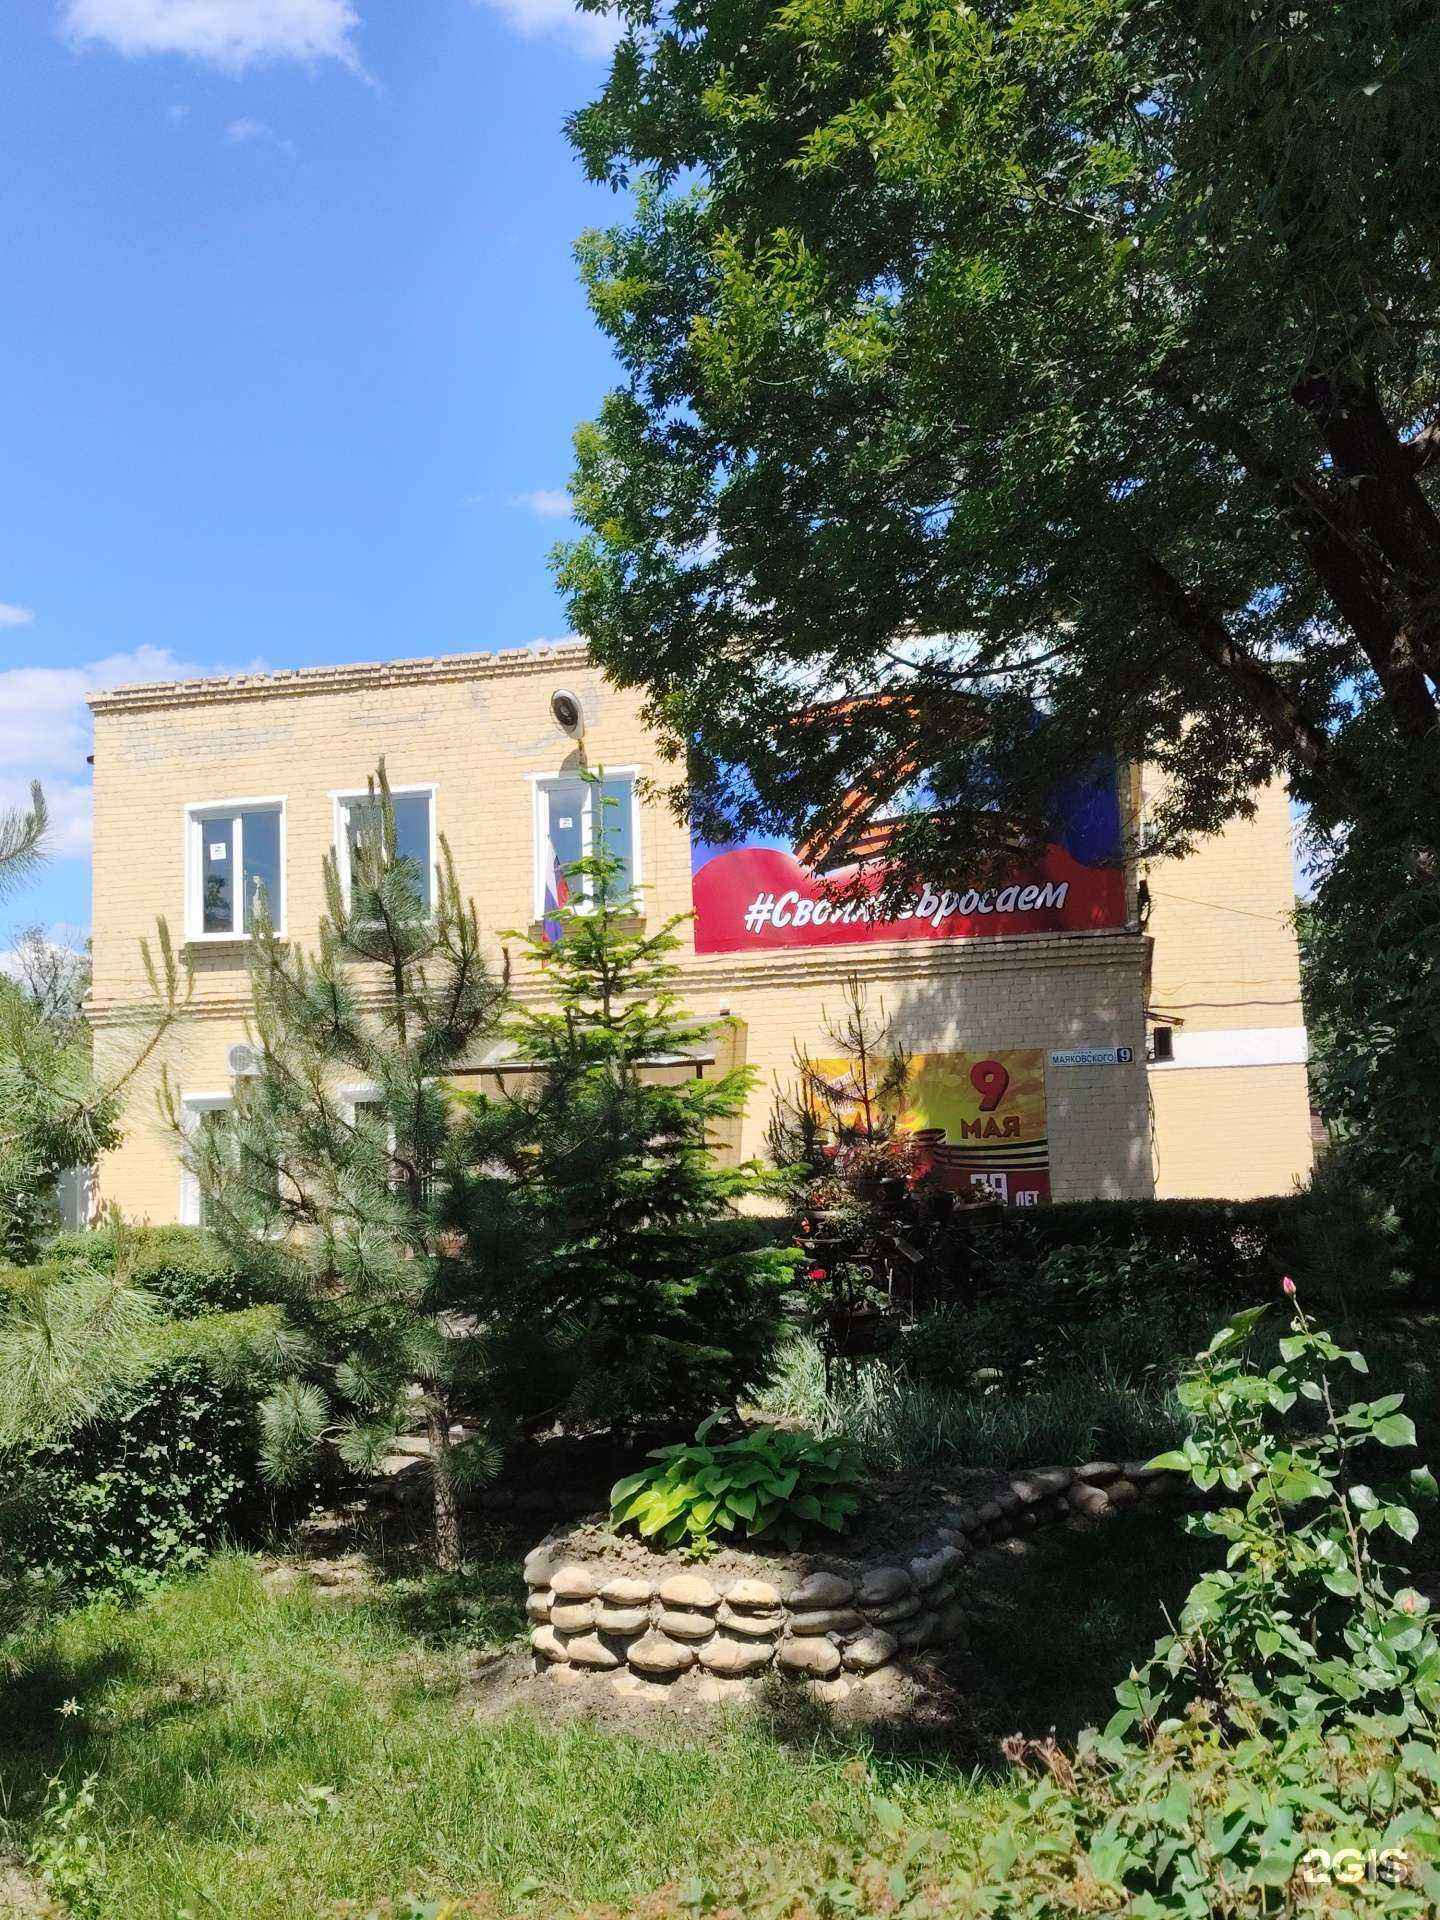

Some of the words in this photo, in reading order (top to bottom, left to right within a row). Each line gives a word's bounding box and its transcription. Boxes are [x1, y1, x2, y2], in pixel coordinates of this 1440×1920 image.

[1052, 1053, 1114, 1064] МАЯКОВСКОГО
[1119, 1048, 1131, 1062] 9
[970, 1060, 1009, 1111] 9
[960, 1115, 1020, 1139] МАЯ
[1016, 1190, 1040, 1207] ЛЕТ
